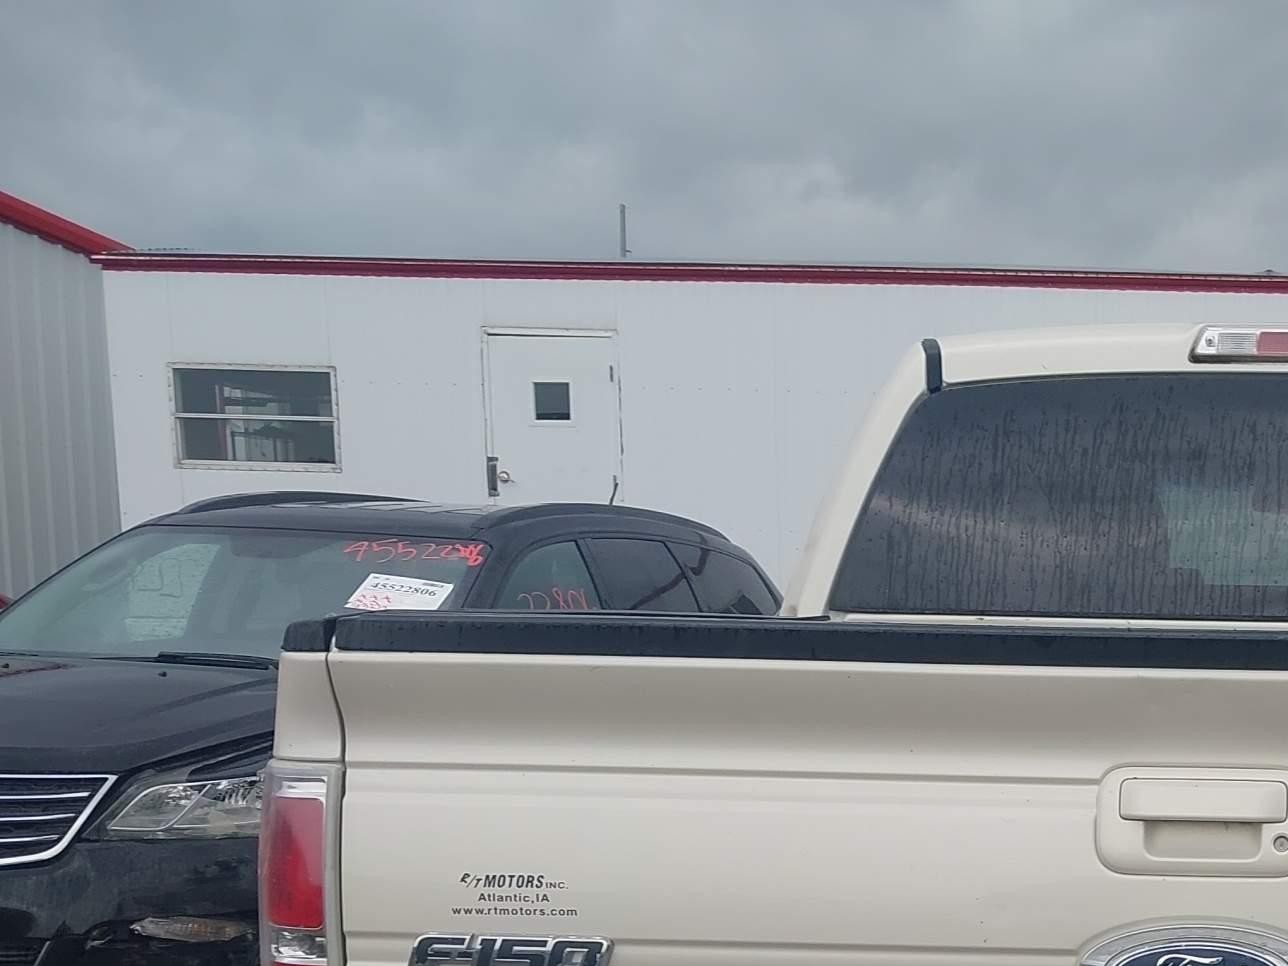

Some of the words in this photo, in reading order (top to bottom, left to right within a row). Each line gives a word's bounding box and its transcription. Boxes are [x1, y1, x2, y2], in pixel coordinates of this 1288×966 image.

[370, 581, 437, 597] 45522806
[483, 874, 545, 889] MOTORS
[545, 881, 569, 890] INC.
[451, 906, 578, 916] www.rtmotors.com
